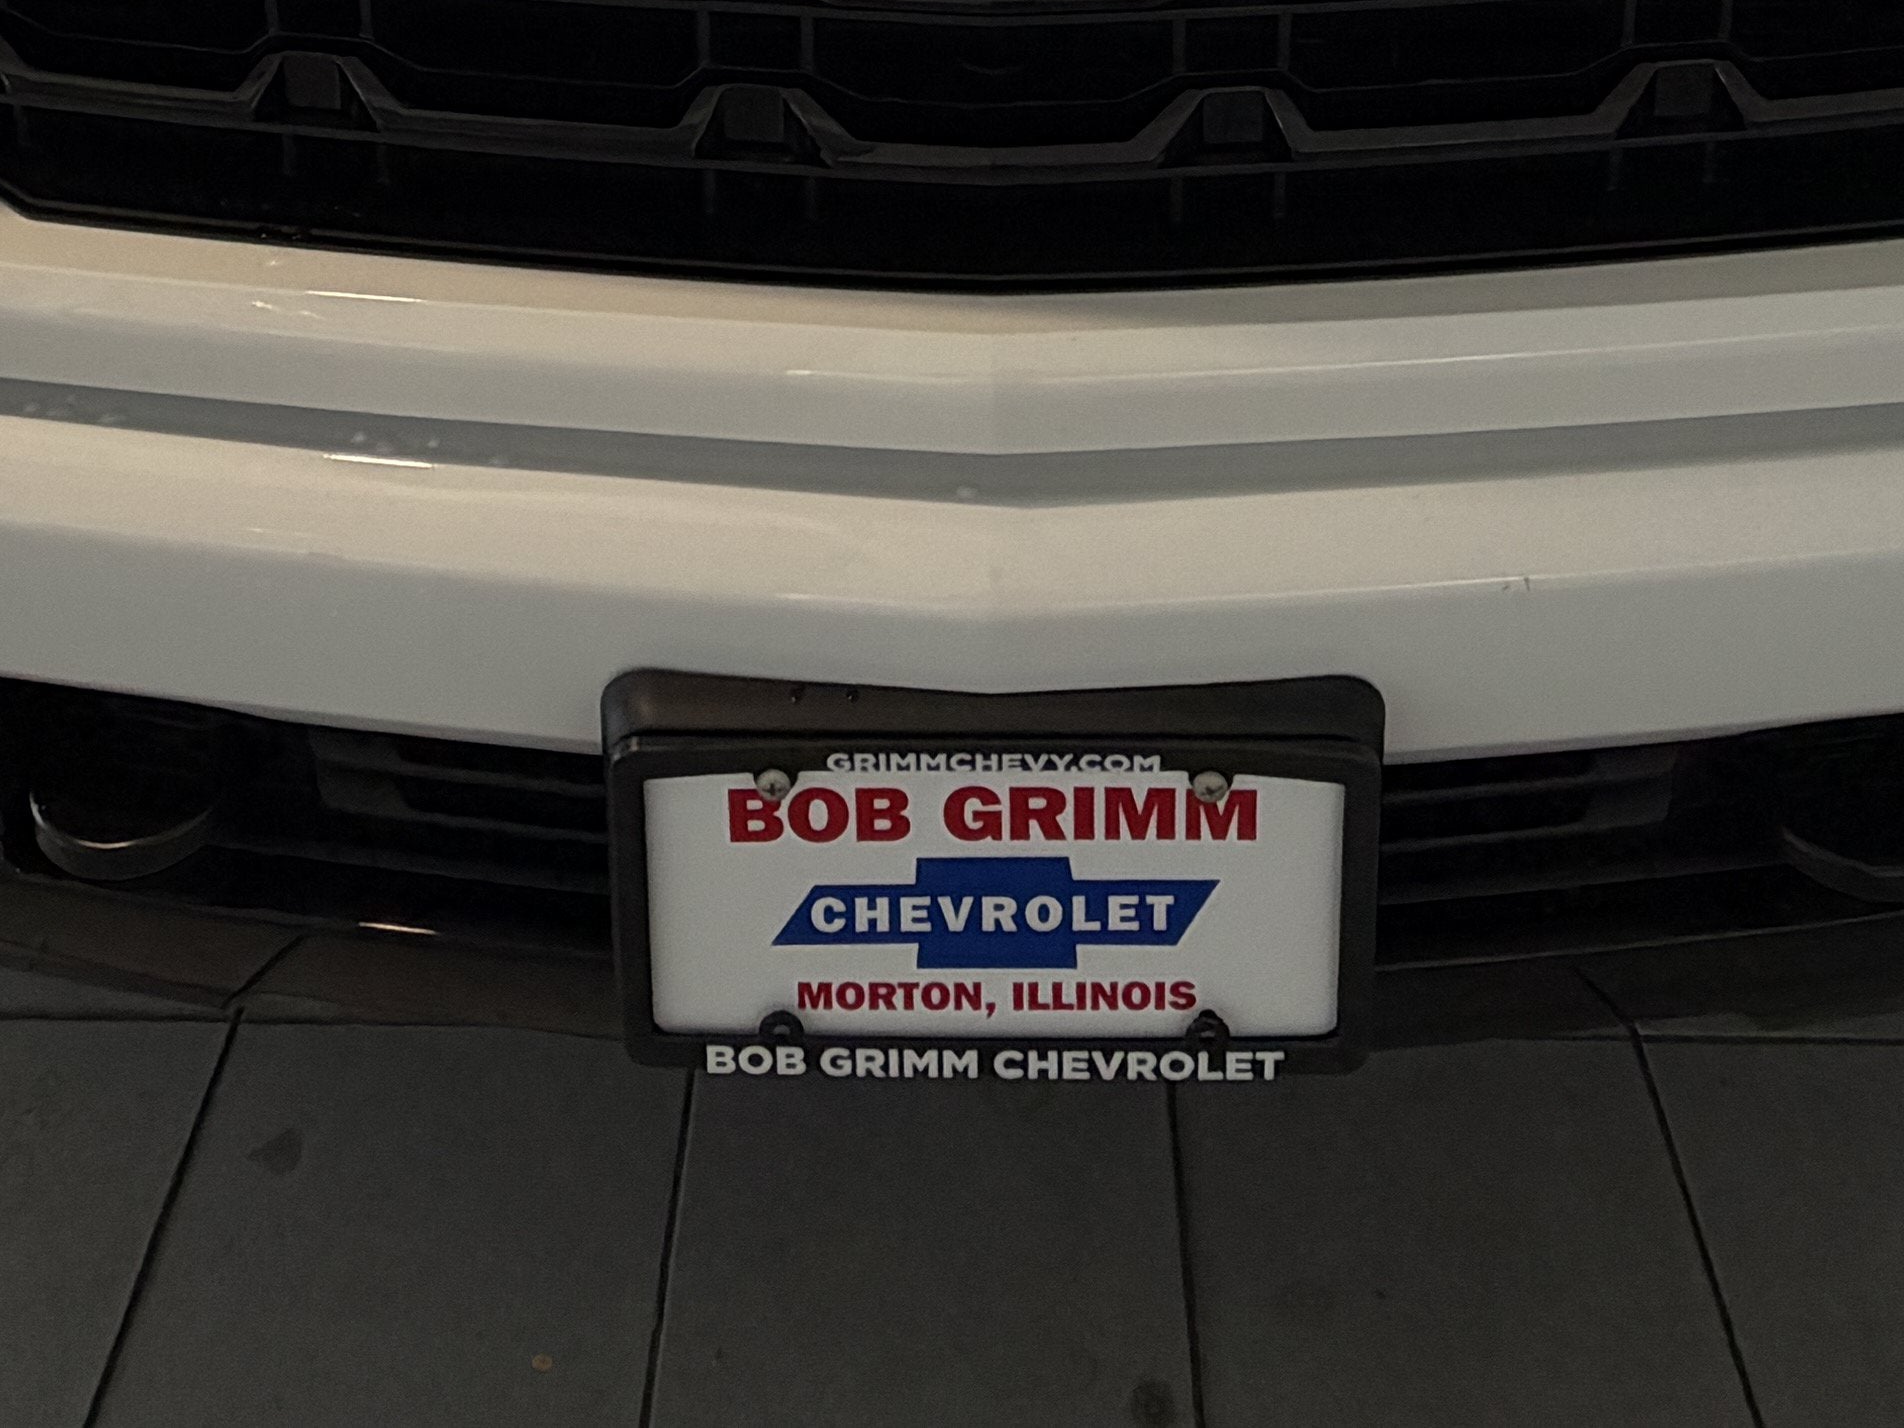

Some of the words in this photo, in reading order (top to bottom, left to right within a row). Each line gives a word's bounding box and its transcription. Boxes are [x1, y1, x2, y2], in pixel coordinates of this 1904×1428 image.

[826, 752, 1162, 773] GRIMMCHEVY.COM
[727, 786, 912, 843] BOB
[943, 785, 1258, 842] GRIMM
[810, 895, 1175, 933] CHEVROLET
[797, 981, 996, 1019] MORTON,
[1012, 981, 1198, 1011] ILLINOIS
[706, 1045, 807, 1076] BOB
[819, 1047, 979, 1079] GRIMM
[993, 1049, 1286, 1081] CHEVROLET
